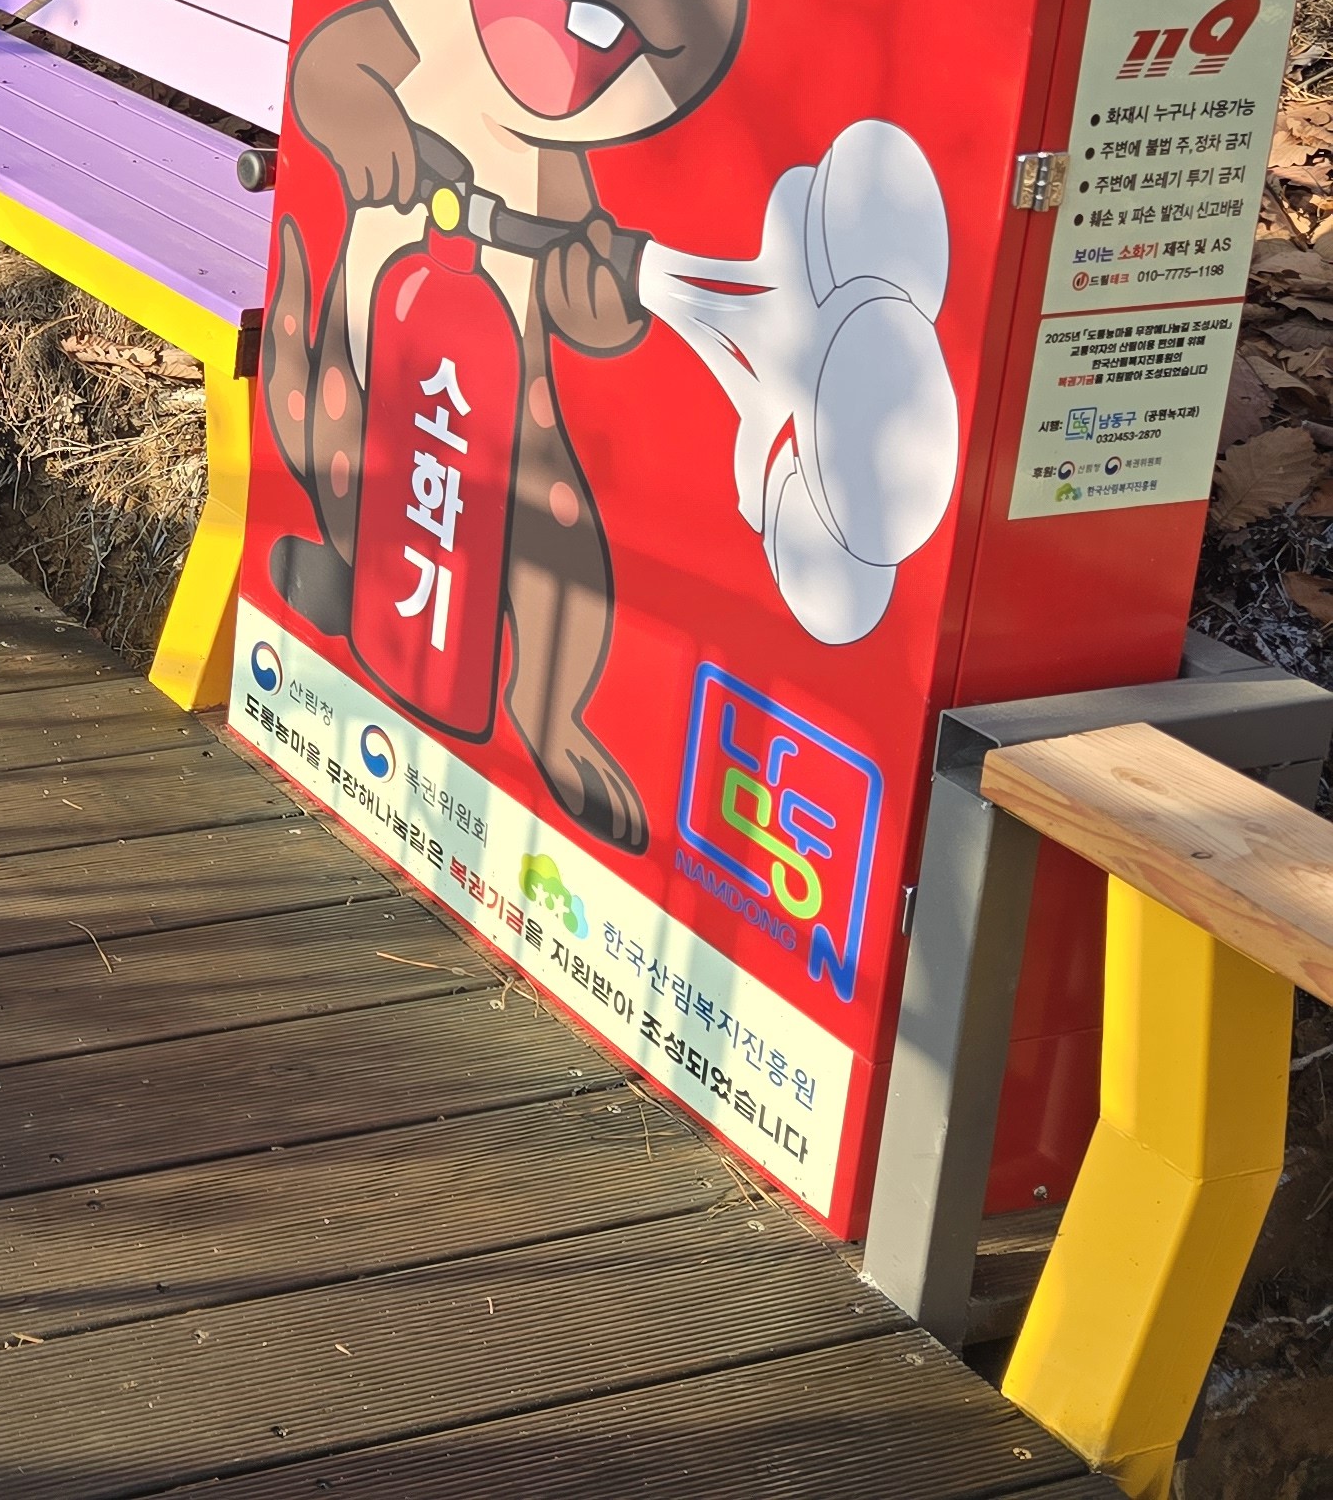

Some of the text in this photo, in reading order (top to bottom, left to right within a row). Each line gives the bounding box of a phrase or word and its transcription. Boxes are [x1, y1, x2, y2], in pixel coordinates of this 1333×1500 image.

[1106, 98, 1255, 125] 화재시 누구나 사용가능
[1100, 140, 1142, 160] 주변에
[1146, 137, 1172, 157] 불법
[1225, 131, 1252, 150] 금지
[1095, 165, 1245, 194] 주변에 쓰레기 투기 금지
[1118, 211, 1128, 225] 및
[1131, 206, 1156, 224] 파손
[1072, 237, 1232, 264] 보이는 소화기 제작 및 AS
[1137, 264, 1224, 282] 010-7775-1198
[1045, 331, 1081, 344] 2025년
[1099, 412, 1137, 429] 남동구
[1096, 429, 1162, 444] 032)453-2870
[394, 357, 472, 652] 소화기
[289, 678, 816, 1111] 산림청 복권위원회 한국산림복지진흥원
[676, 848, 797, 950] NAMDONG
[450, 855, 543, 952] 복권기금을
[551, 937, 634, 1024] 지원받아
[640, 1010, 809, 1164] 조성되었습니다
